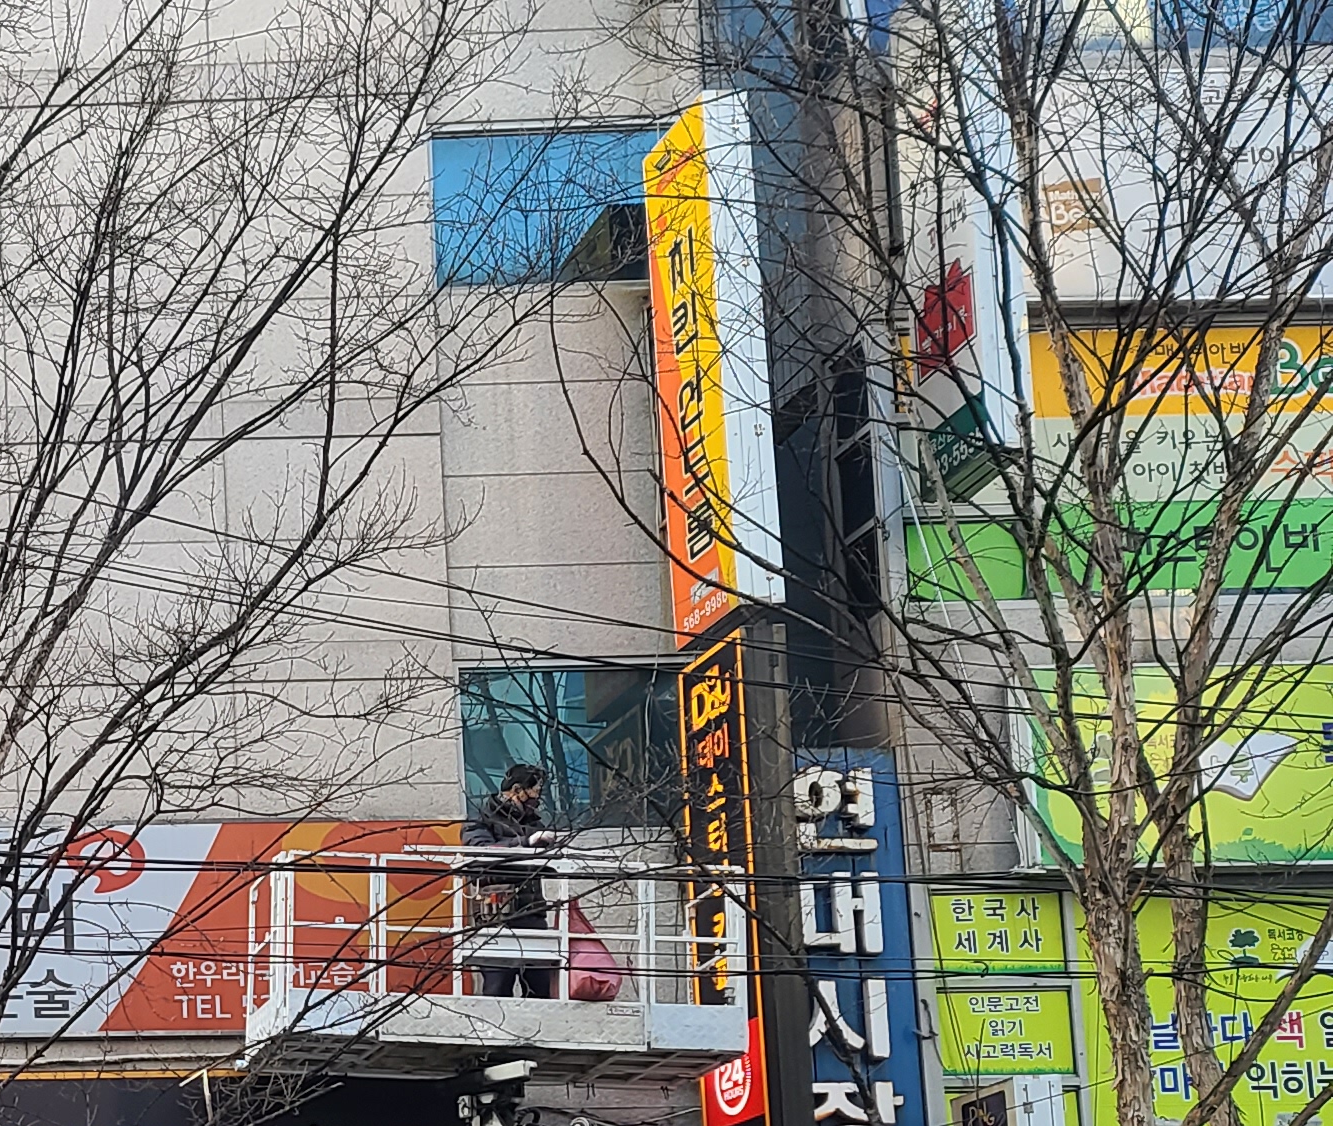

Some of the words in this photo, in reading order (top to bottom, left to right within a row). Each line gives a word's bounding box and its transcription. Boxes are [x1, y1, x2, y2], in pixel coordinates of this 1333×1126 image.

[1131, 460, 1179, 483] 아이
[173, 994, 232, 1020] TEL
[968, 995, 1041, 1013] 인문고전
